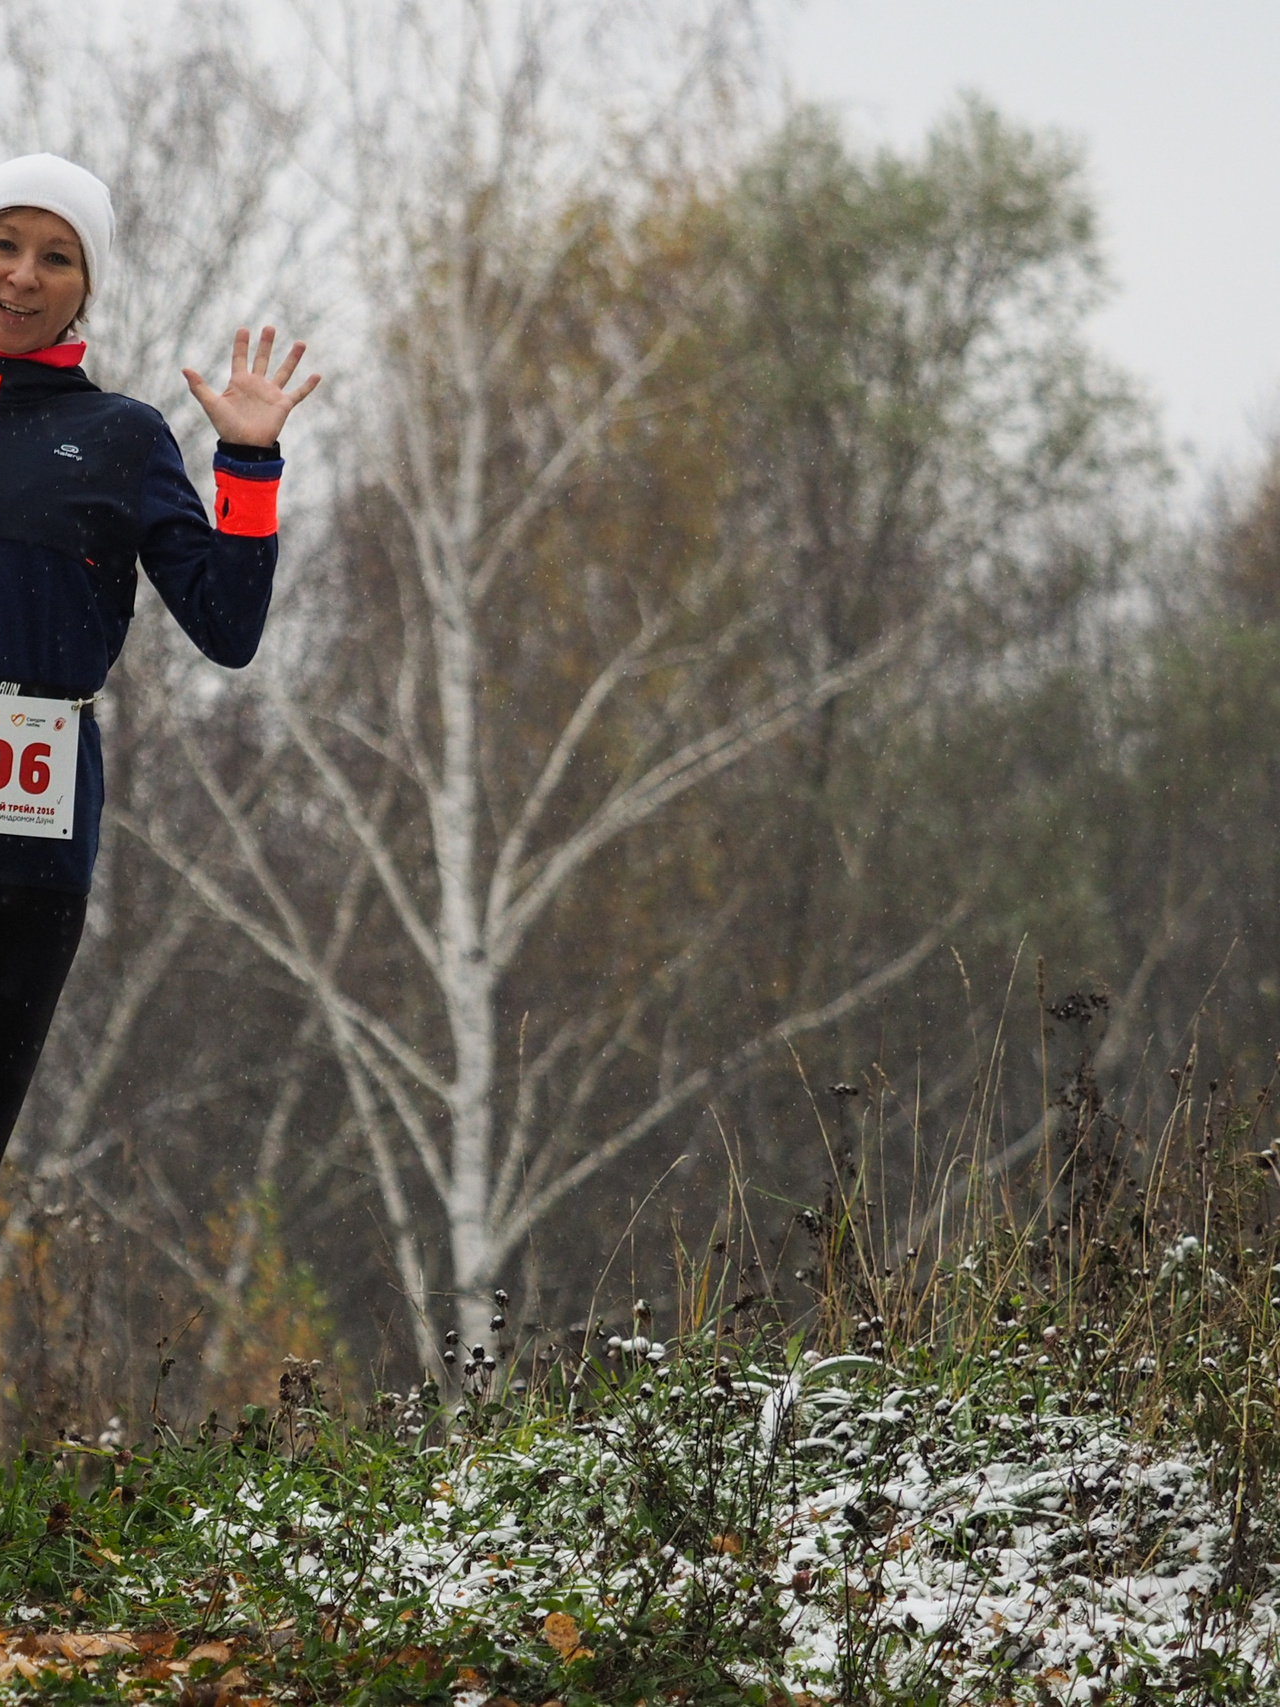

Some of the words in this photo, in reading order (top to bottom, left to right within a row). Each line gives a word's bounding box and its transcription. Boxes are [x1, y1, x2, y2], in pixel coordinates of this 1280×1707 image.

[8, 803, 35, 814] ТРЕЙЛ
[36, 806, 55, 816] 2016
[35, 816, 55, 826] Дауна
